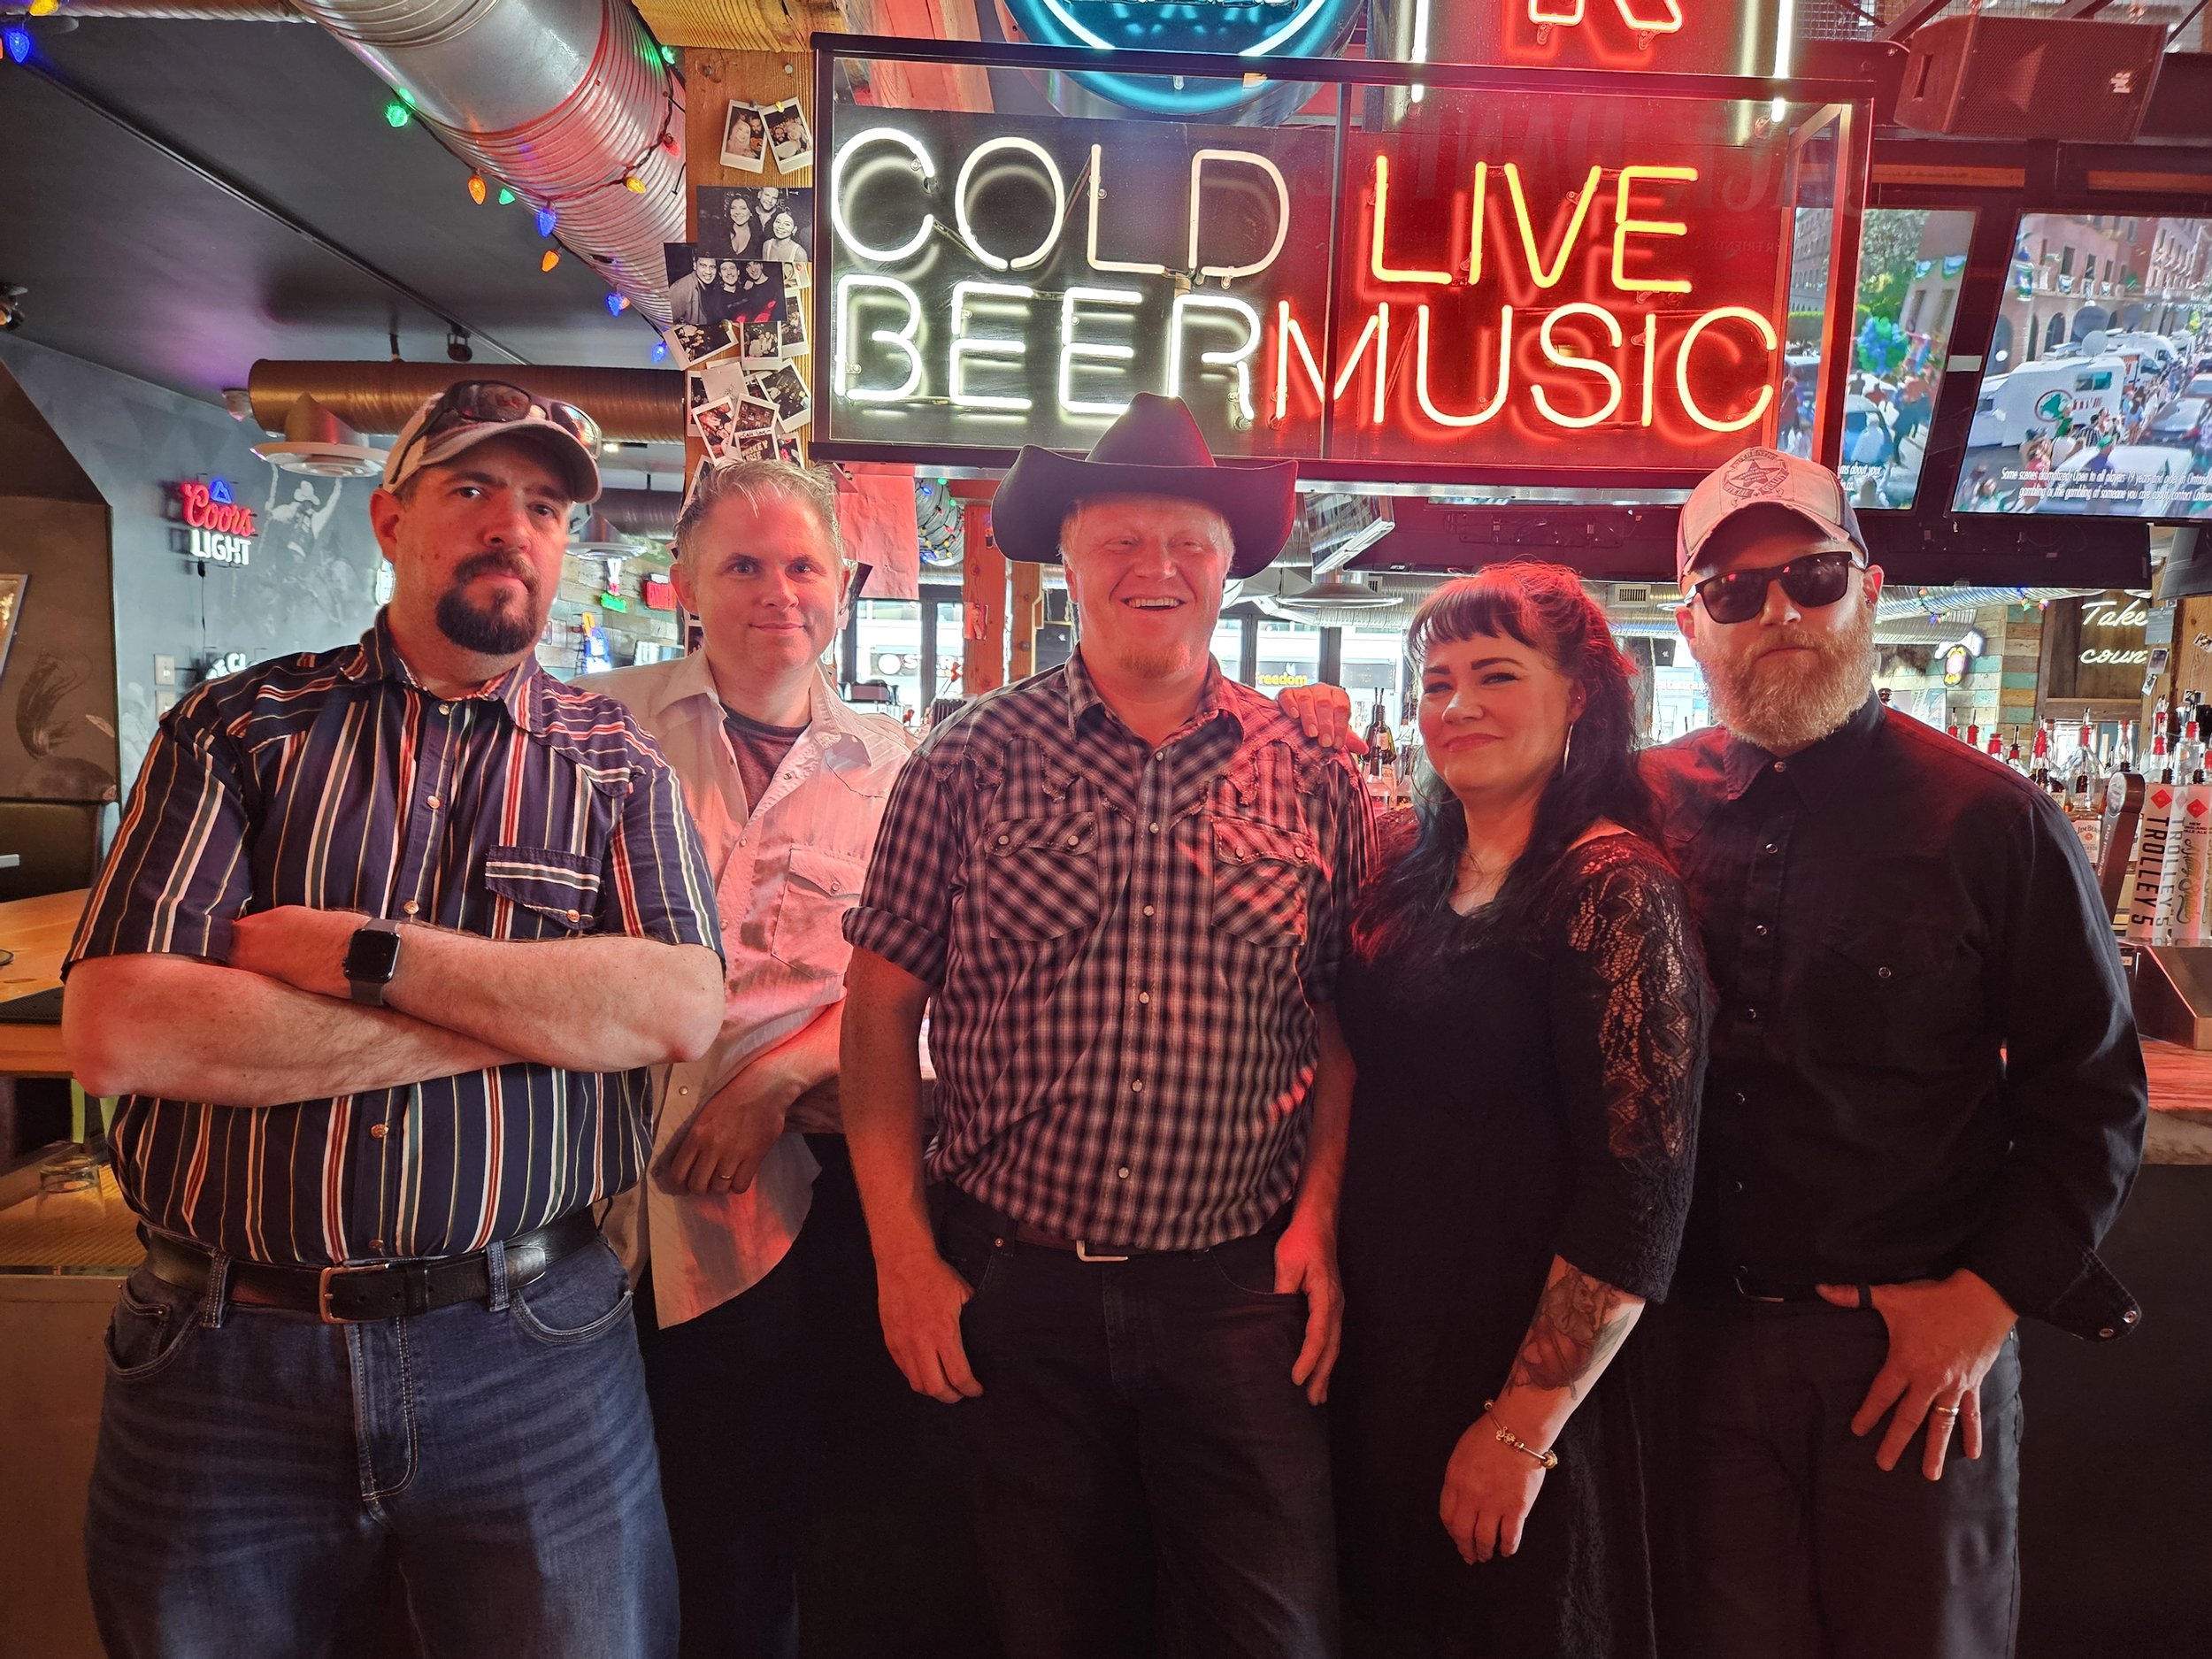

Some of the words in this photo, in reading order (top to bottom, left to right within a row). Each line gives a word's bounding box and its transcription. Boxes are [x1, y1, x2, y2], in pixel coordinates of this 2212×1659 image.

[831, 127, 1290, 279] COLD
[1371, 155, 1699, 293] LIVE
[833, 274, 1261, 419] BEER
[1276, 300, 1778, 432] MUSIC
[2001, 467, 2017, 480] Some
[2018, 471, 2038, 480] scenes
[2073, 470, 2088, 484] Open
[2097, 469, 2107, 482] all
[2018, 483, 2047, 500] gambling
[2064, 484, 2093, 500] gambling
[182, 483, 255, 537] Coors
[191, 529, 251, 565] LIGHT
[2081, 598, 2149, 626] Take
[2097, 841, 2108, 876] Original
[2134, 817, 2170, 908] TROLLEY
[2159, 817, 2185, 910] TROLLEY
[2131, 914, 2154, 926] 5
